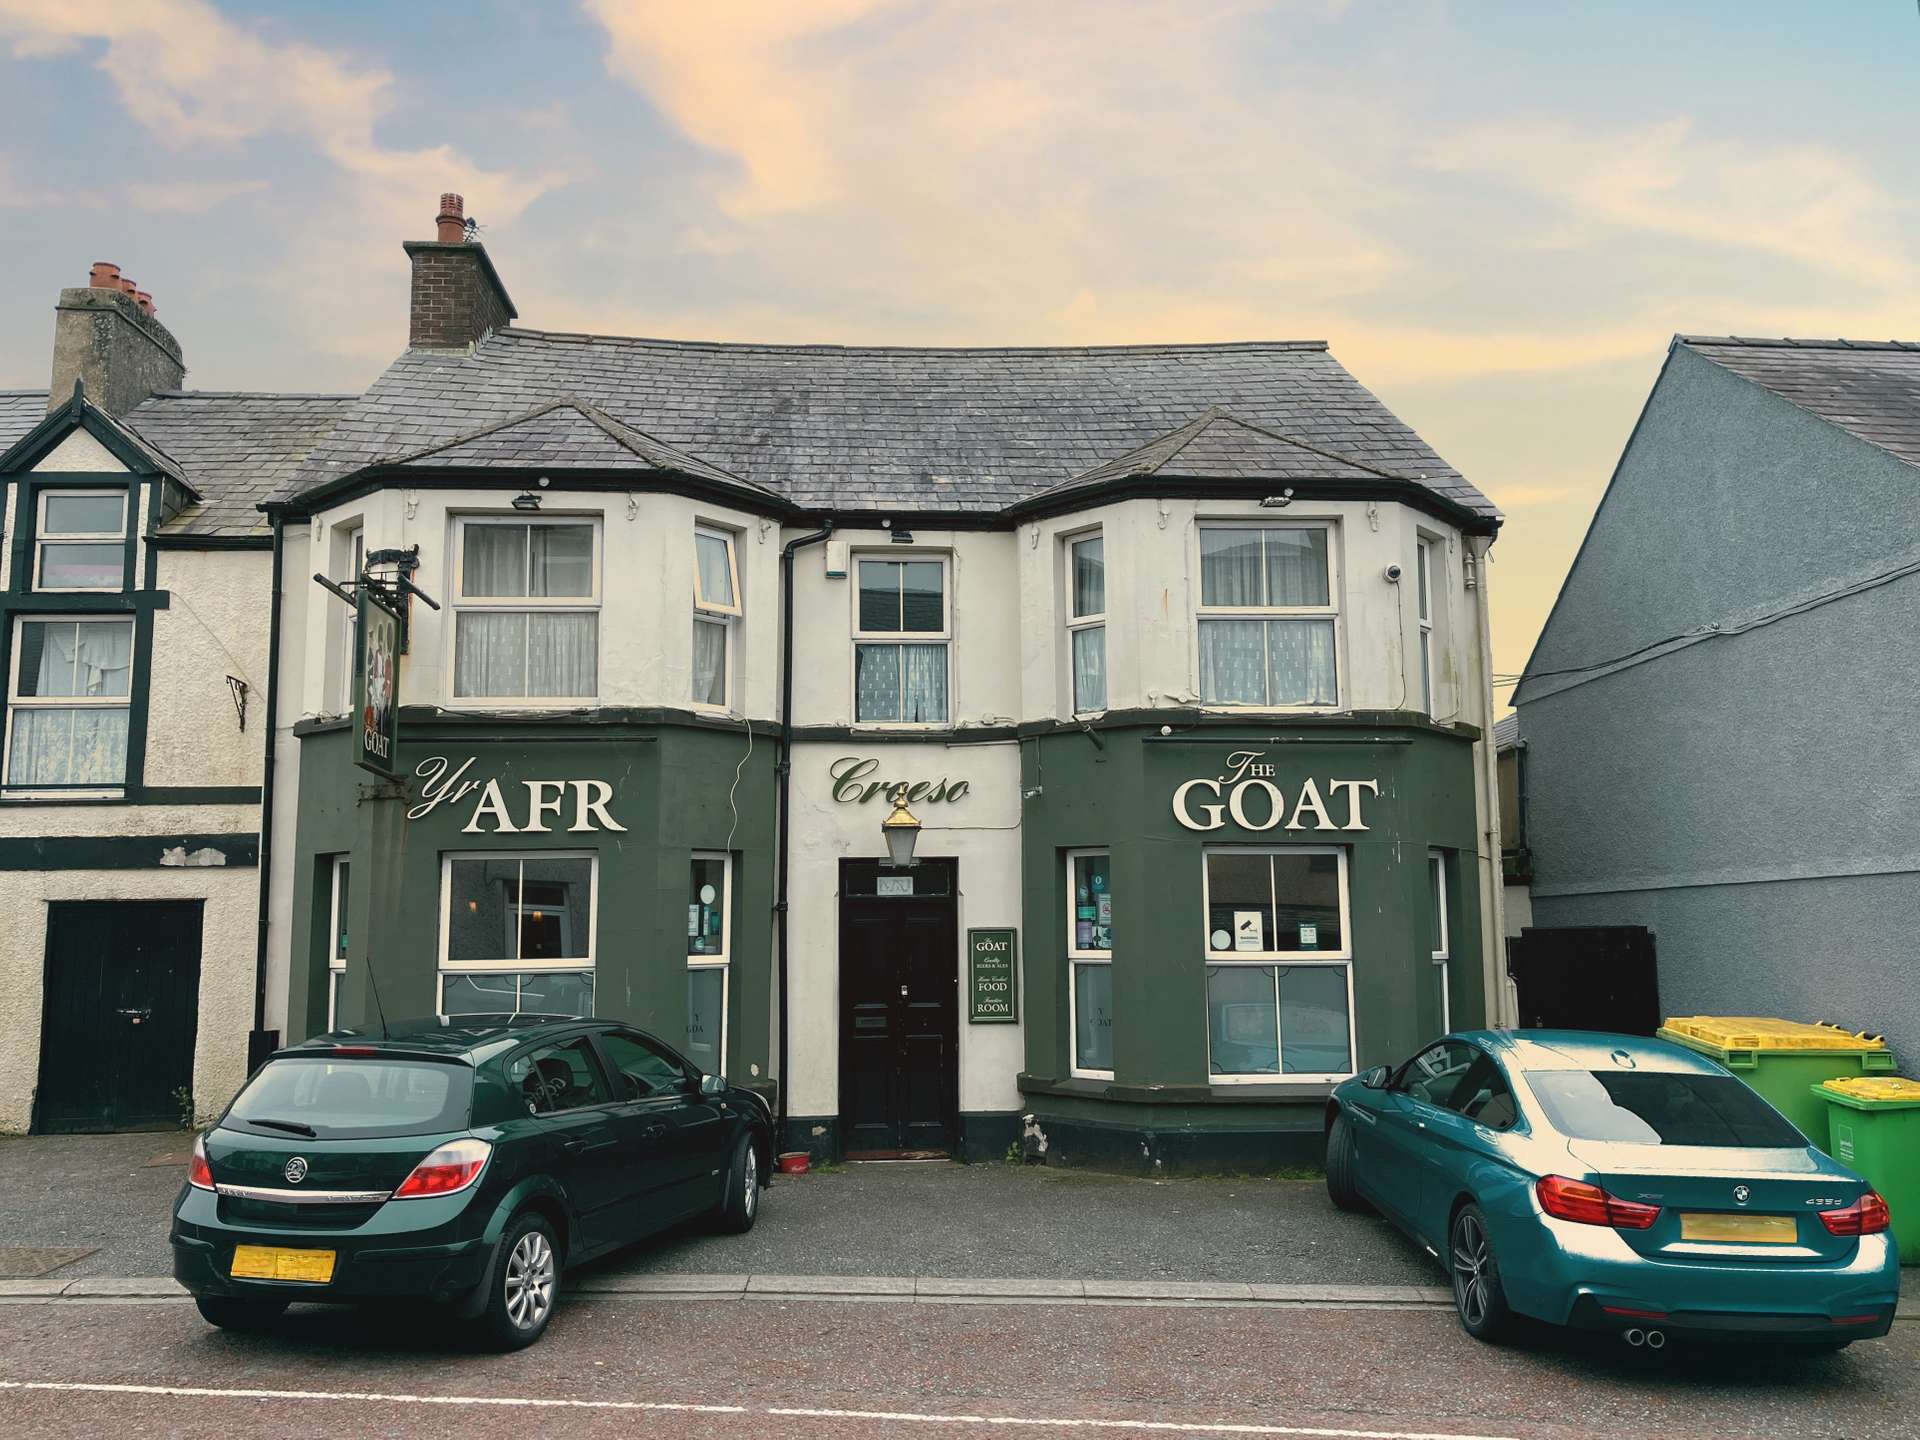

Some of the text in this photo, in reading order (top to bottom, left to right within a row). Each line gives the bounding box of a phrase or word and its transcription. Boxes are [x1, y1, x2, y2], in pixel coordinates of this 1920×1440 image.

[364, 728, 390, 759] GOAT
[407, 756, 628, 833] Yr AFR
[829, 756, 970, 804] Croeso
[1172, 777, 1380, 831] GOAT
[976, 942, 1008, 951] GOAT
[978, 982, 1008, 991] FOOD
[977, 1003, 1009, 1012] ROOM
